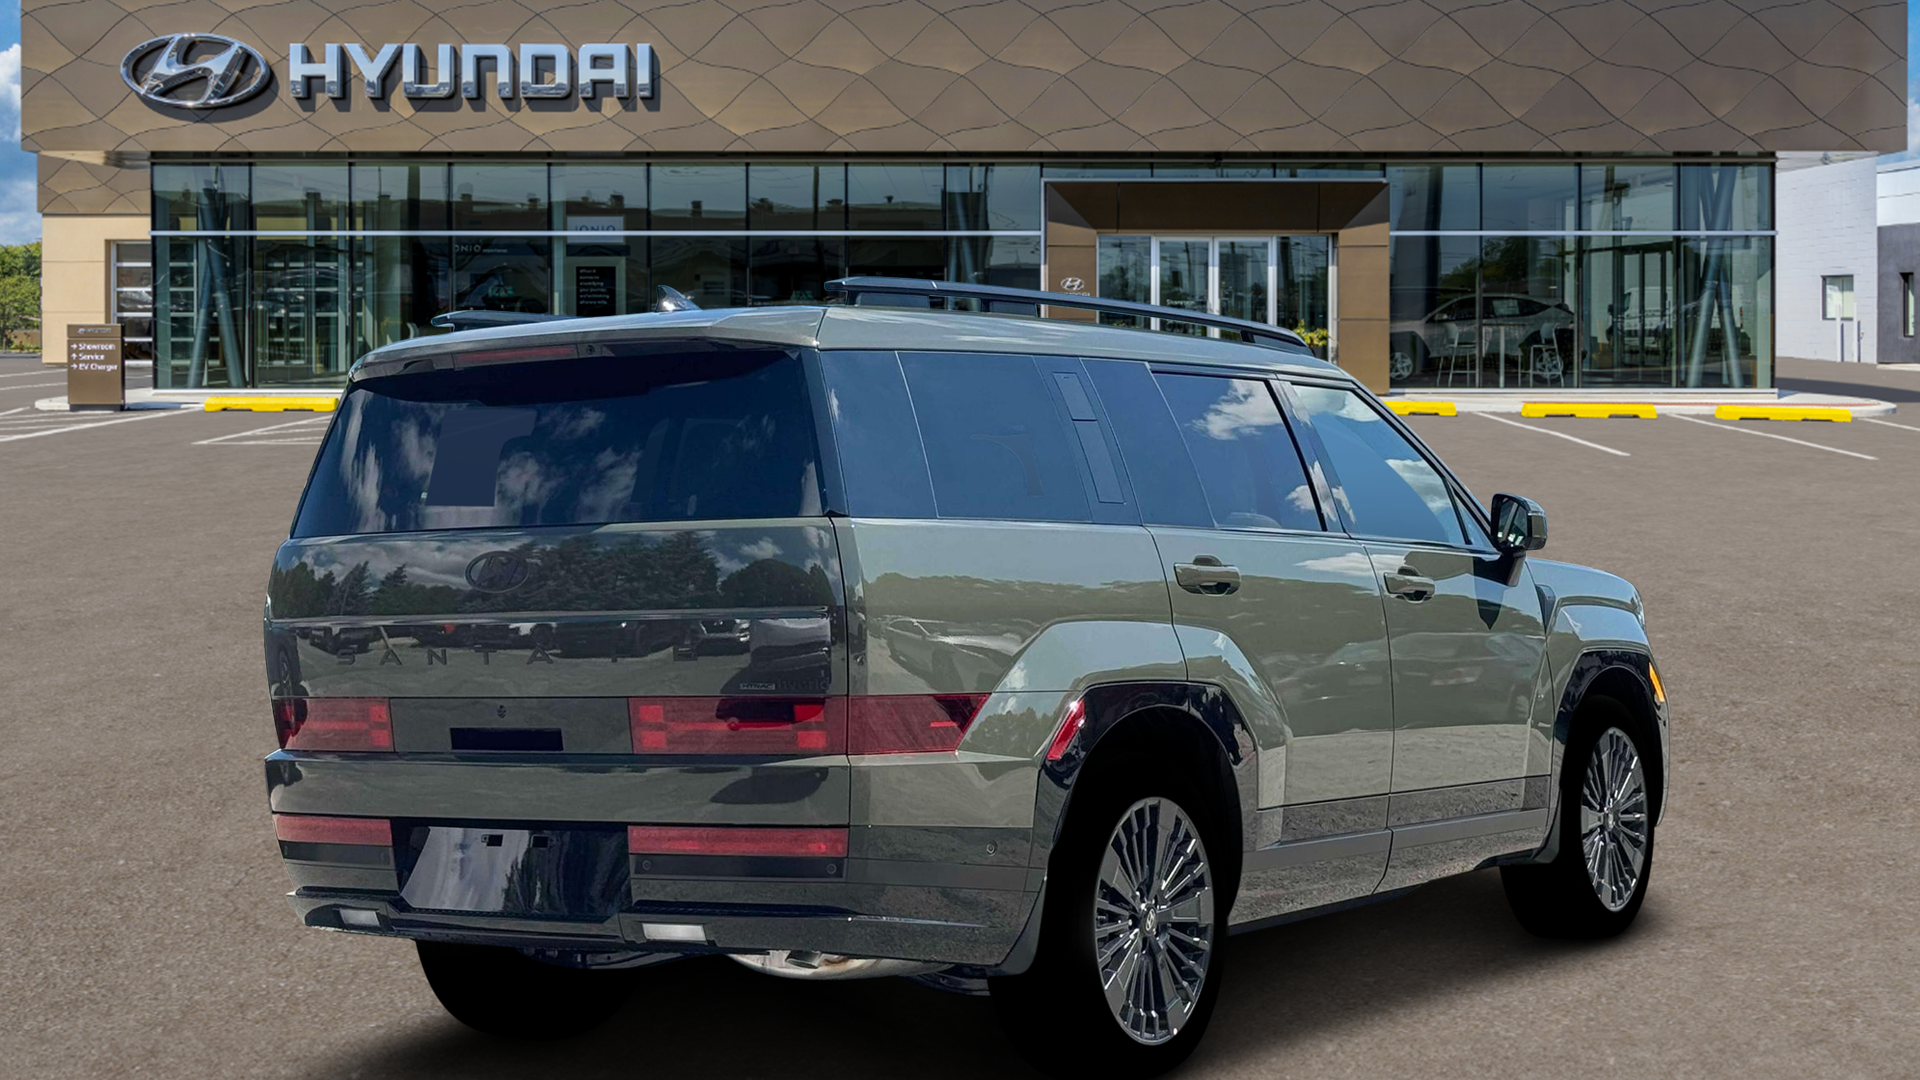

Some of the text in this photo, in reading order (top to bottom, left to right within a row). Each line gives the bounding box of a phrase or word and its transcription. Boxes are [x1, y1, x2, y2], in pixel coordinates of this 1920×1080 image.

[289, 42, 656, 101] HYUNDAI
[78, 343, 116, 351] Showroom
[78, 352, 105, 361] Service
[78, 362, 118, 372] EV Charger
[336, 647, 555, 666] SANTA
